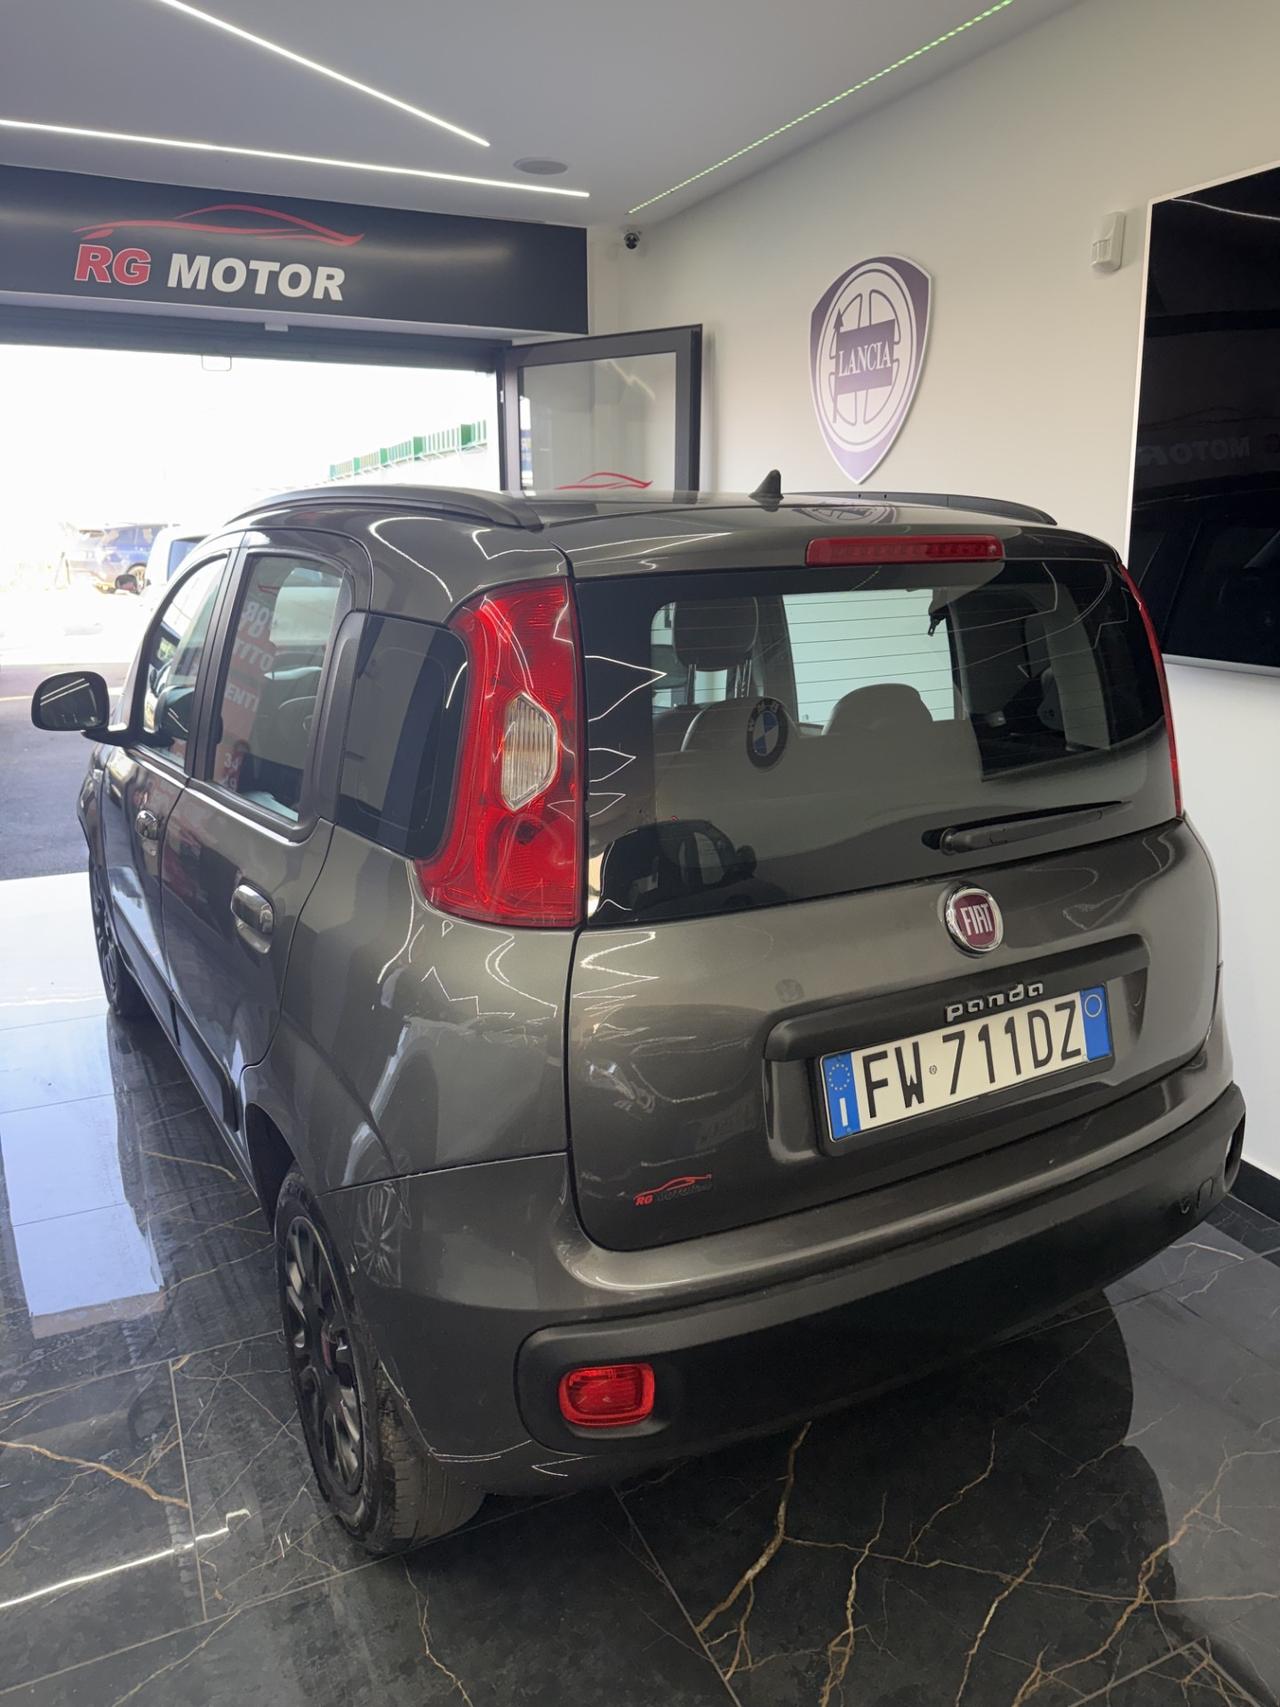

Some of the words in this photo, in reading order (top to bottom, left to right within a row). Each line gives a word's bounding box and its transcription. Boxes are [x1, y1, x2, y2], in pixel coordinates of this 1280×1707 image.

[74, 244, 151, 286] RG
[167, 253, 346, 301] MOTOR
[838, 340, 892, 377] LANCIA
[960, 903, 994, 936] FIAT
[945, 983, 1044, 1022] panda
[862, 1041, 926, 1119] FW
[942, 1000, 1082, 1096] 711DZ
